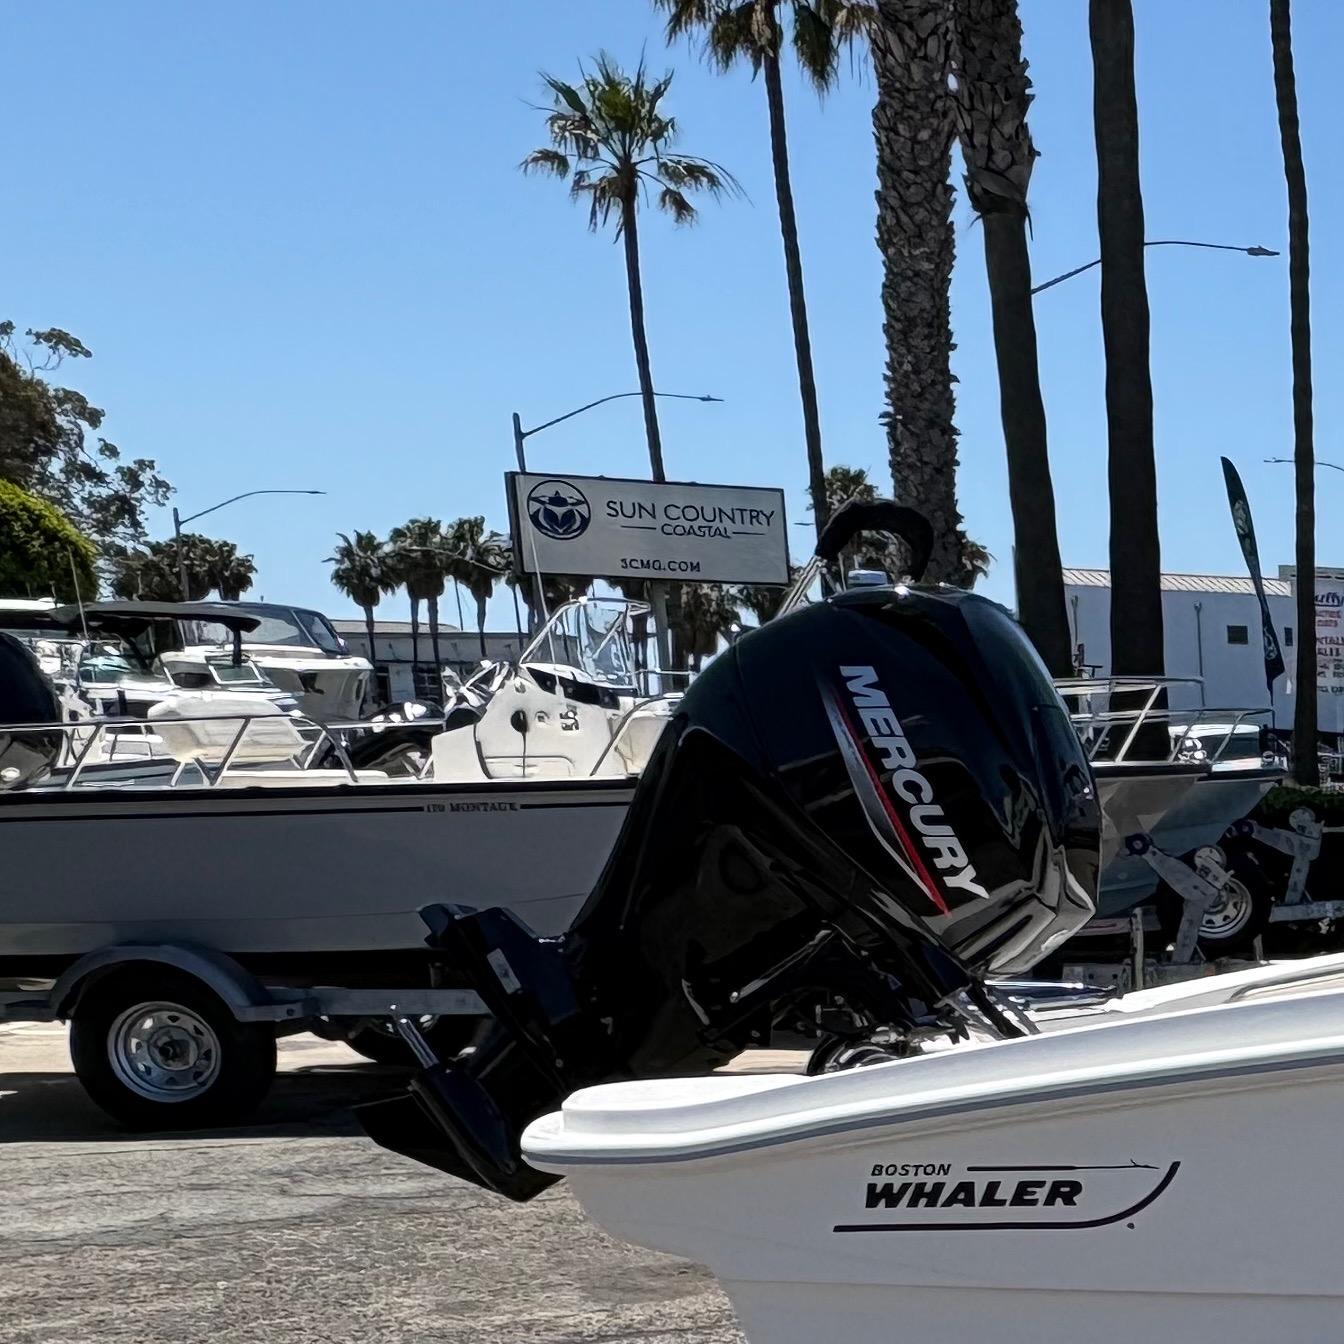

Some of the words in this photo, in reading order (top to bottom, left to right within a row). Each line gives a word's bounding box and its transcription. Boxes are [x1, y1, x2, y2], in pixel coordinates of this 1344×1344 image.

[606, 500, 657, 519] SUN
[663, 503, 775, 527] COUNTRY
[661, 523, 732, 539] COASTAL
[839, 665, 990, 899] MERCURY
[870, 1163, 951, 1176] BOSTON
[865, 1180, 1083, 1209] WHALER
